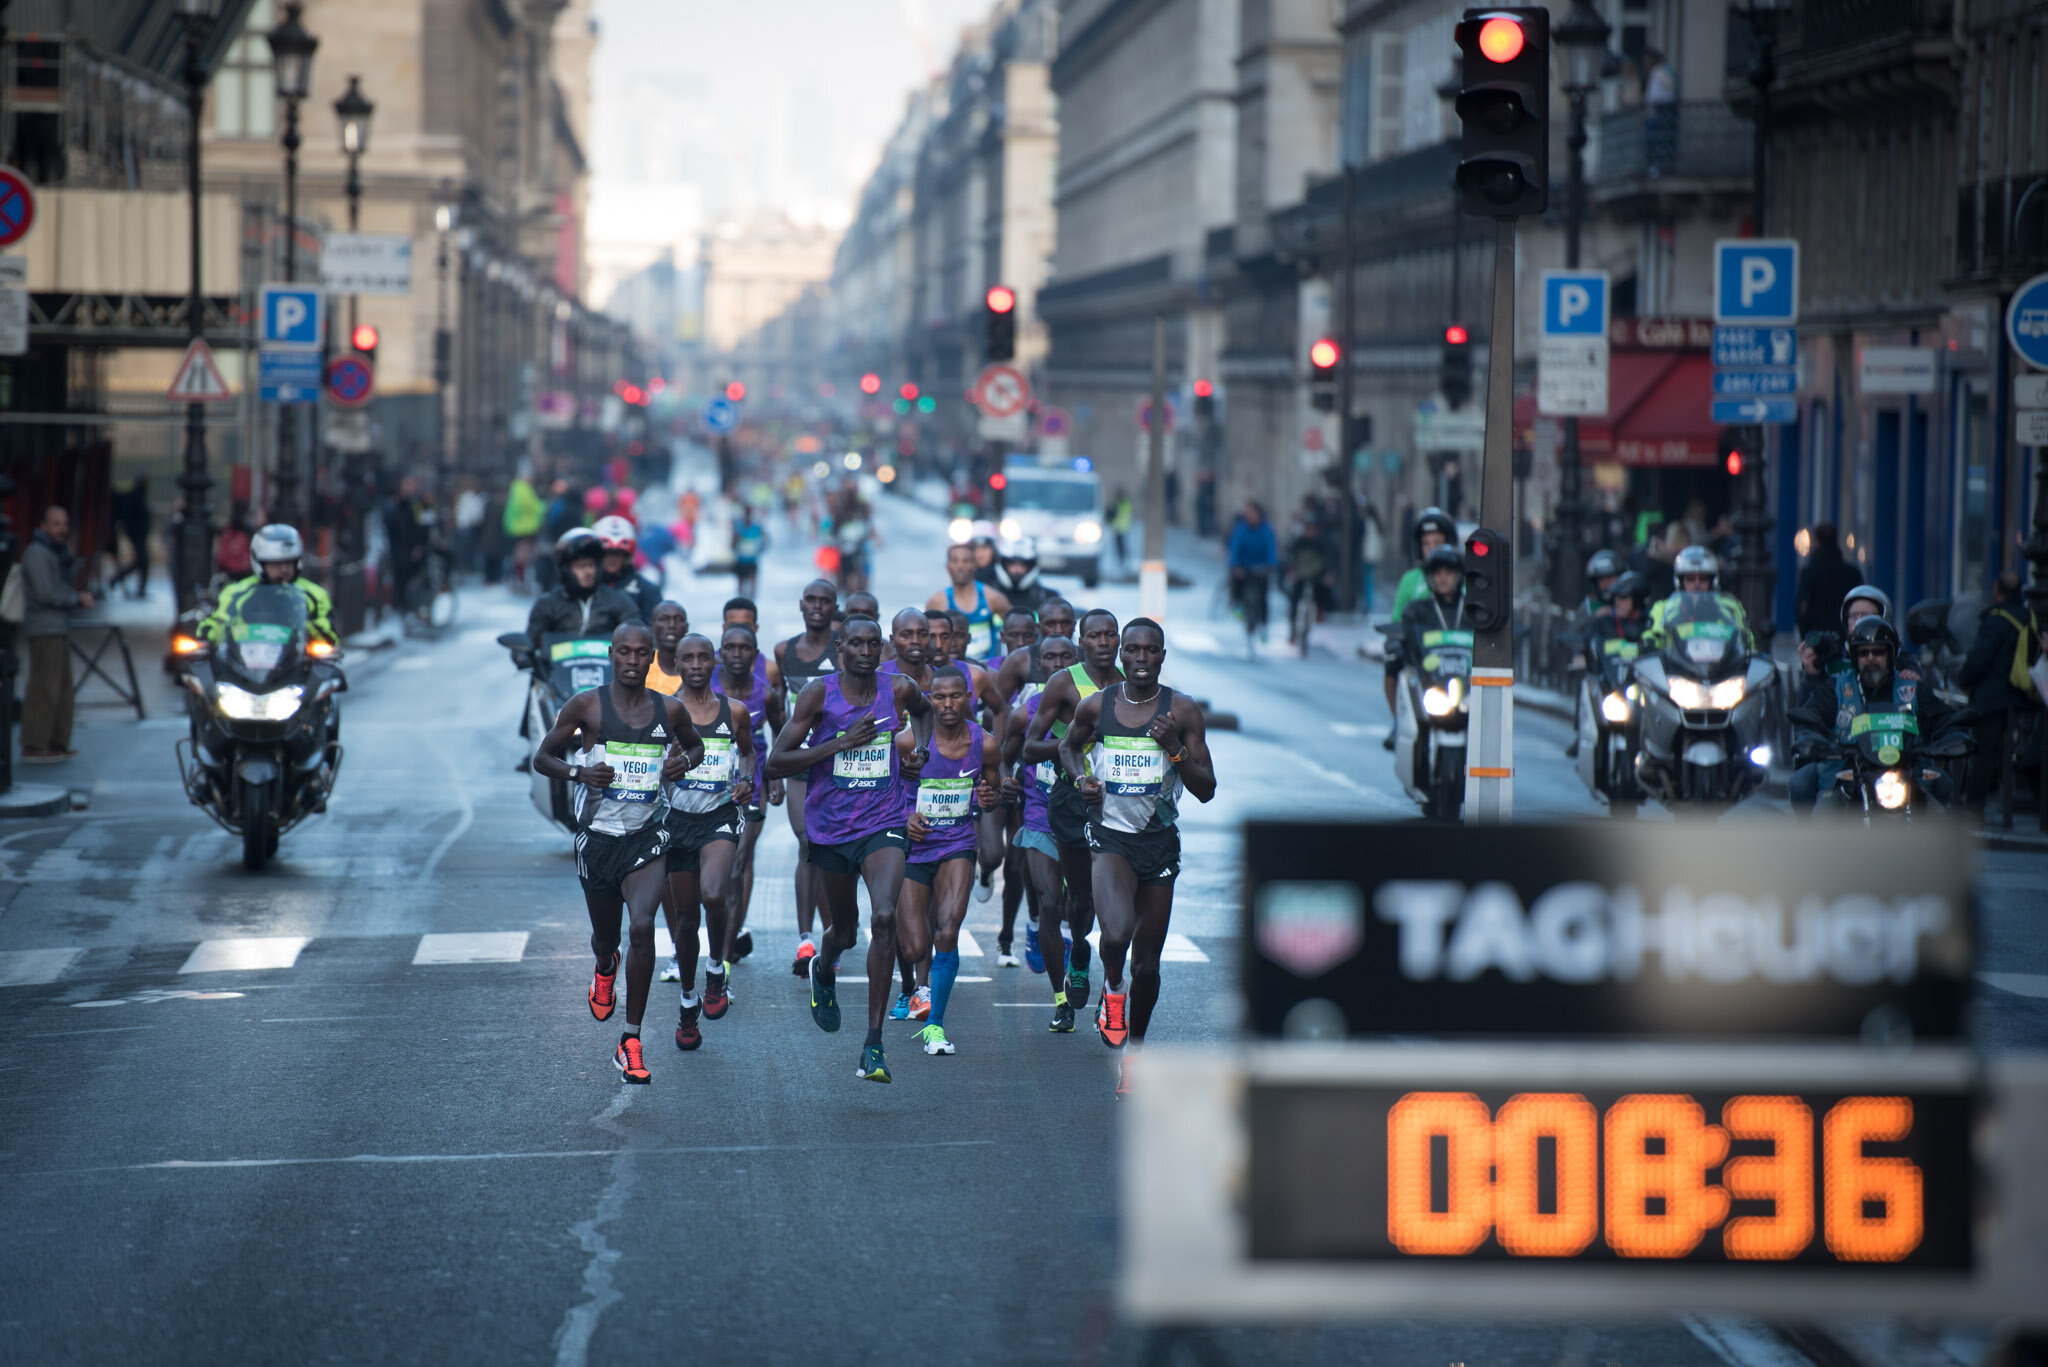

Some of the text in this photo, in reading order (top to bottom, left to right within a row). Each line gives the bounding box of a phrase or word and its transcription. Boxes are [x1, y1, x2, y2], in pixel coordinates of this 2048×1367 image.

[1741, 256, 1776, 308] P
[1559, 284, 1590, 327] P
[276, 296, 307, 338] P
[702, 755, 719, 766] ECH
[843, 749, 885, 762] KIPLAGAT
[1114, 754, 1151, 768] BIRECH
[623, 760, 648, 775] YEGO
[844, 761, 853, 771] 27
[1111, 767, 1121, 776] 26
[614, 773, 623, 783] 28
[932, 793, 960, 804] KORIR
